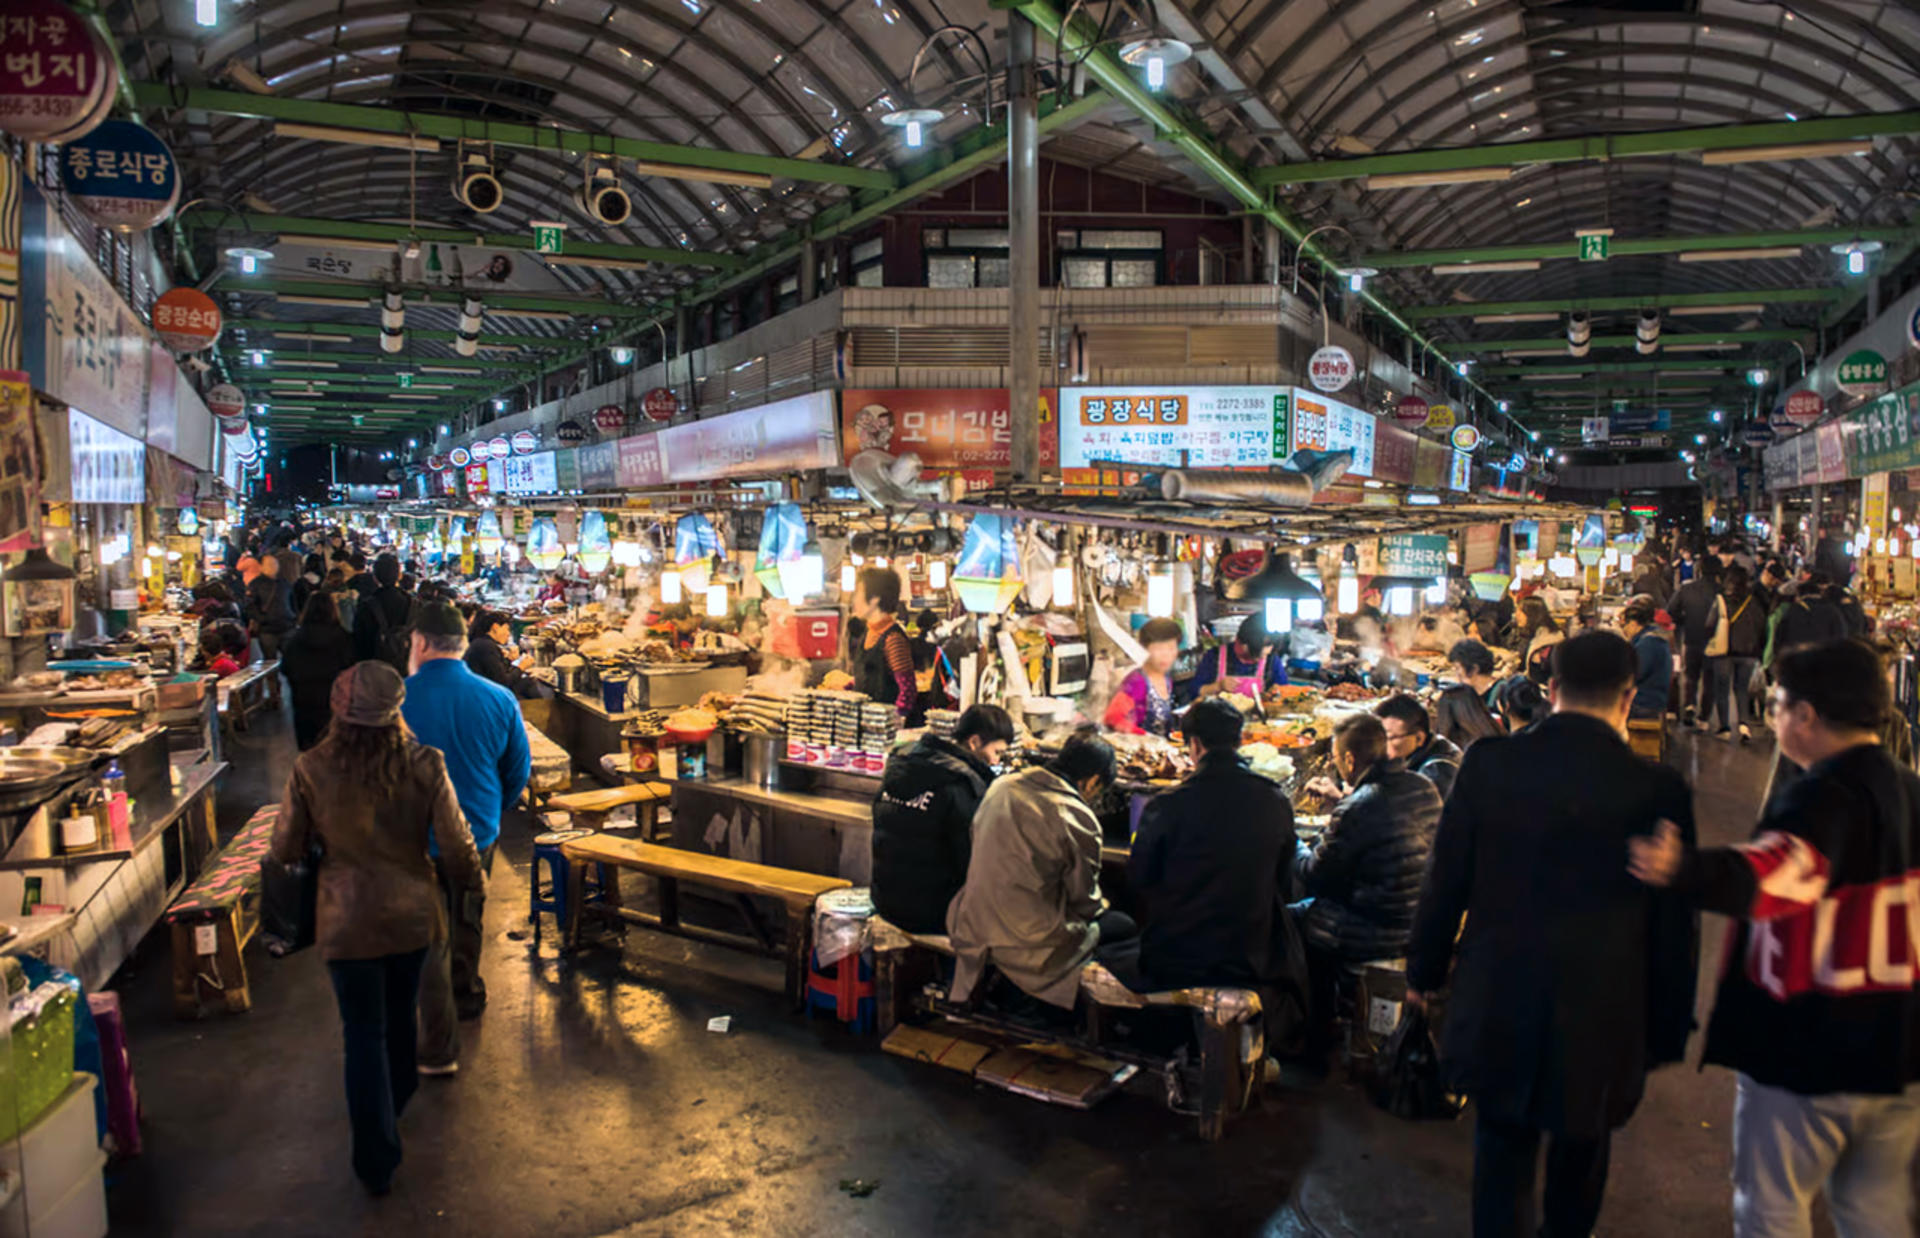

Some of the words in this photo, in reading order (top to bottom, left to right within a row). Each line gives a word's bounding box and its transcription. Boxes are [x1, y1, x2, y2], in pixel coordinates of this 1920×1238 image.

[68, 147, 169, 185] 종로식당
[305, 257, 352, 274] 국순당
[157, 304, 217, 330] 광장순대
[1086, 398, 1181, 423] 광장식당
